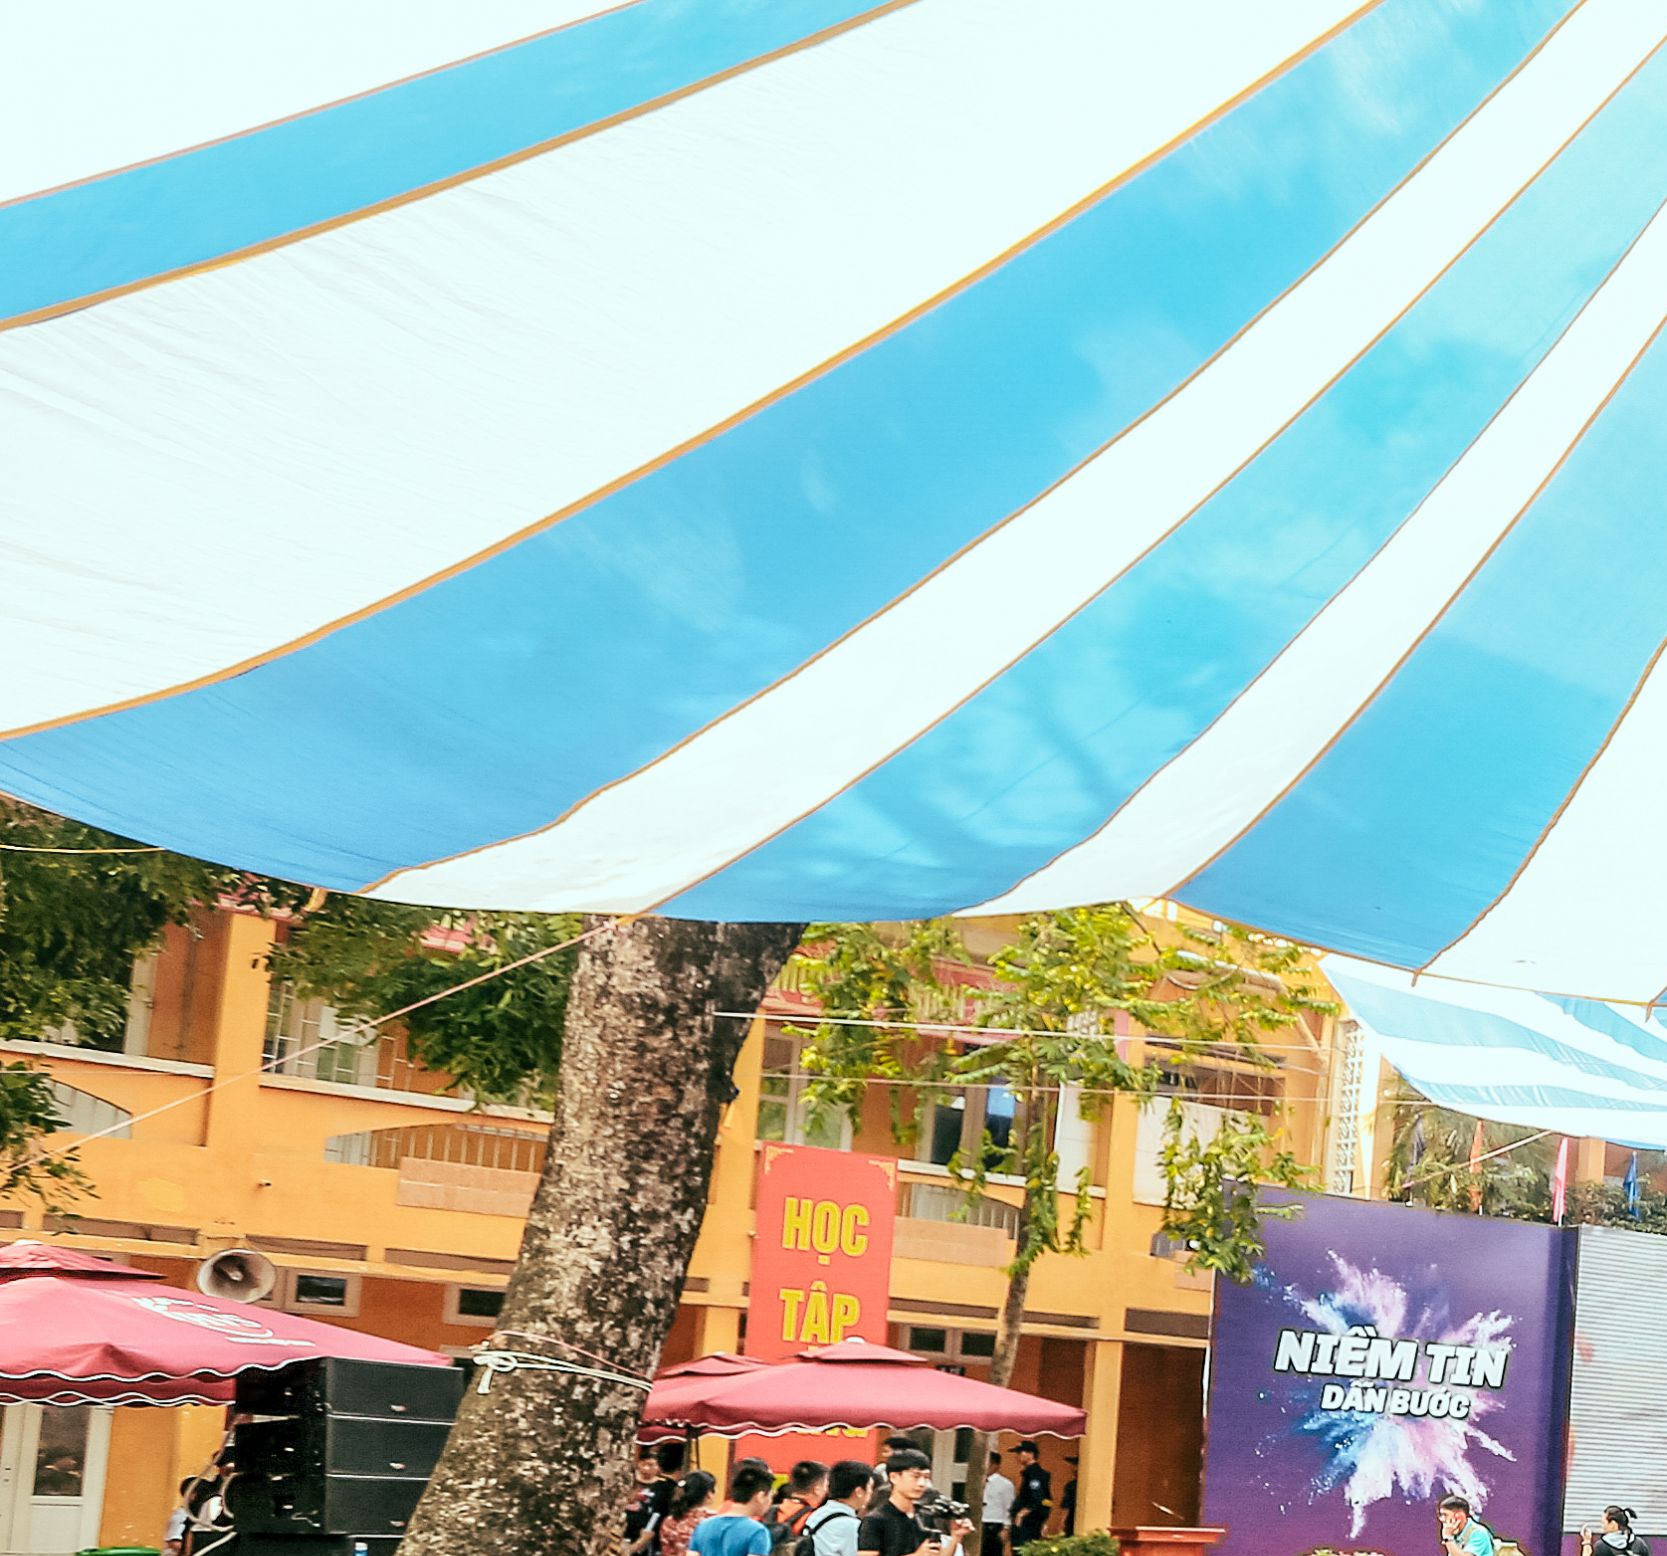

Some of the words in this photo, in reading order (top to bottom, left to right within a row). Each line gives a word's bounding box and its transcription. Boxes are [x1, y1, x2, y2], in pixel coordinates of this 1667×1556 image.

[781, 1196, 870, 1266] HỌC
[778, 1280, 861, 1352] TẬP
[1274, 1325, 1418, 1381] NIỀM
[1424, 1342, 1509, 1388] TIN
[1320, 1381, 1388, 1413] DẪN
[1389, 1386, 1471, 1419] BƯỚC
